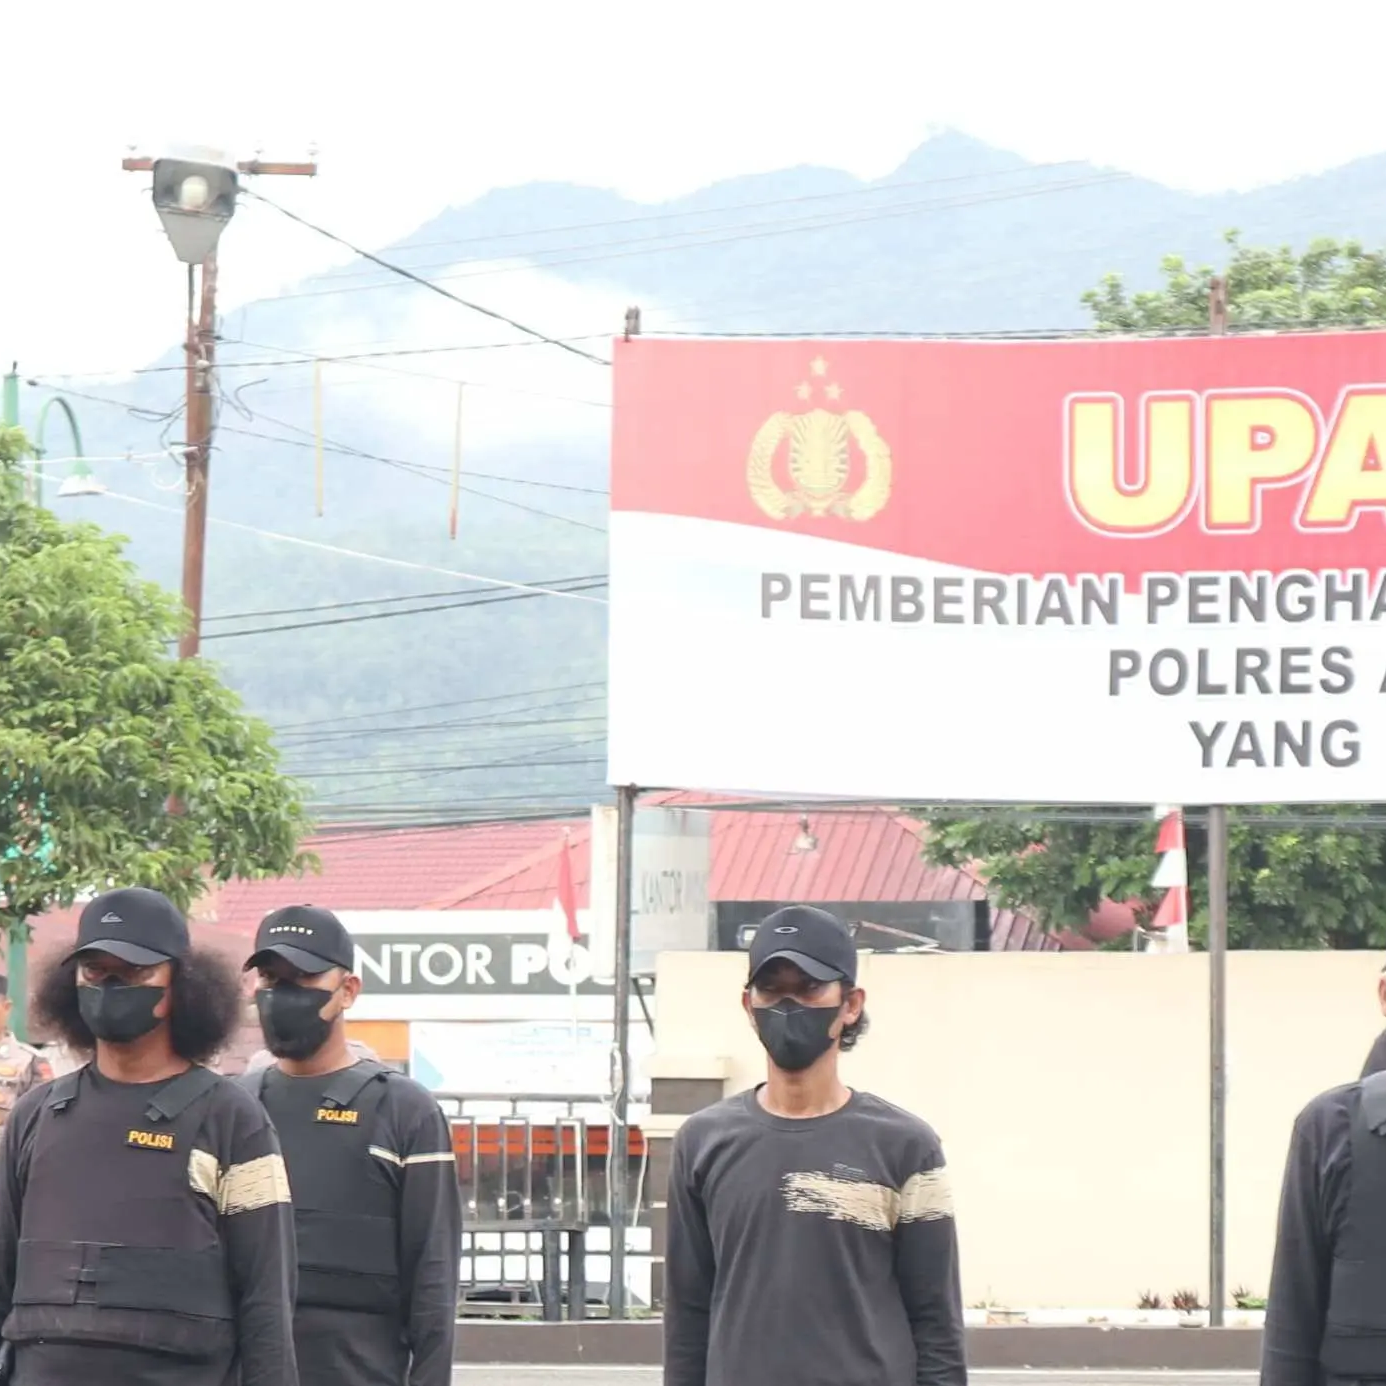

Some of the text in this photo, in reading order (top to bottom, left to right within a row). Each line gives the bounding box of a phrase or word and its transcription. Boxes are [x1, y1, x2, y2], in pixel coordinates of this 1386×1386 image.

[759, 573, 1119, 626] PEMBERIAN
[1106, 646, 1356, 697] POLRES
[1187, 719, 1362, 768] YANG
[127, 1129, 174, 1149] POLISI
[316, 1108, 359, 1123] POLISI
